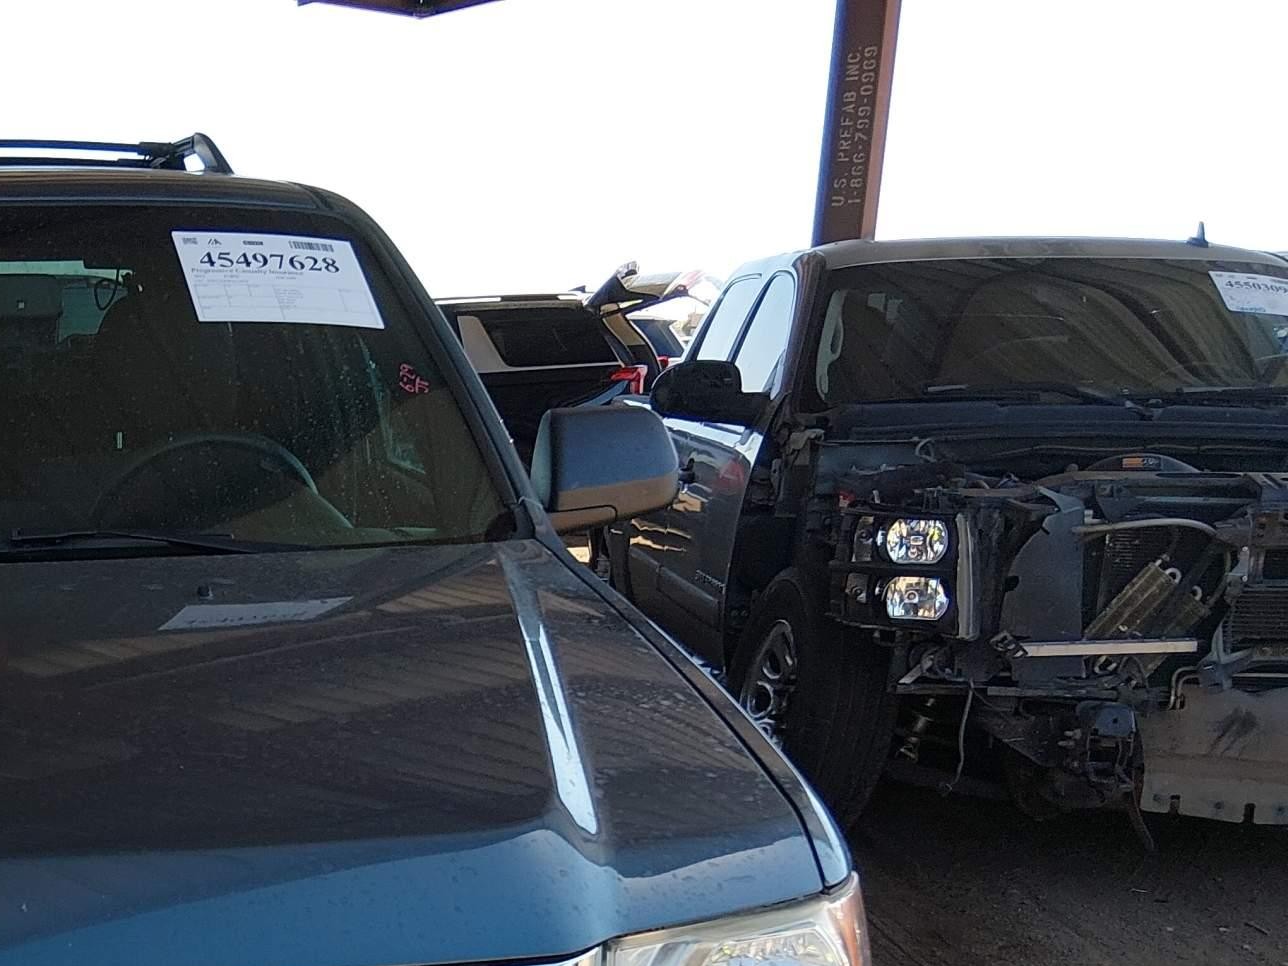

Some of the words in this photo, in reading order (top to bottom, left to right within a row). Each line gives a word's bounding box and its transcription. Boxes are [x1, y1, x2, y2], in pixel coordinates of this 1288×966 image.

[846, 46, 862, 81] INC.
[838, 91, 857, 162] PREFAB
[832, 172, 849, 207] U.S.
[199, 251, 341, 274] 45497628
